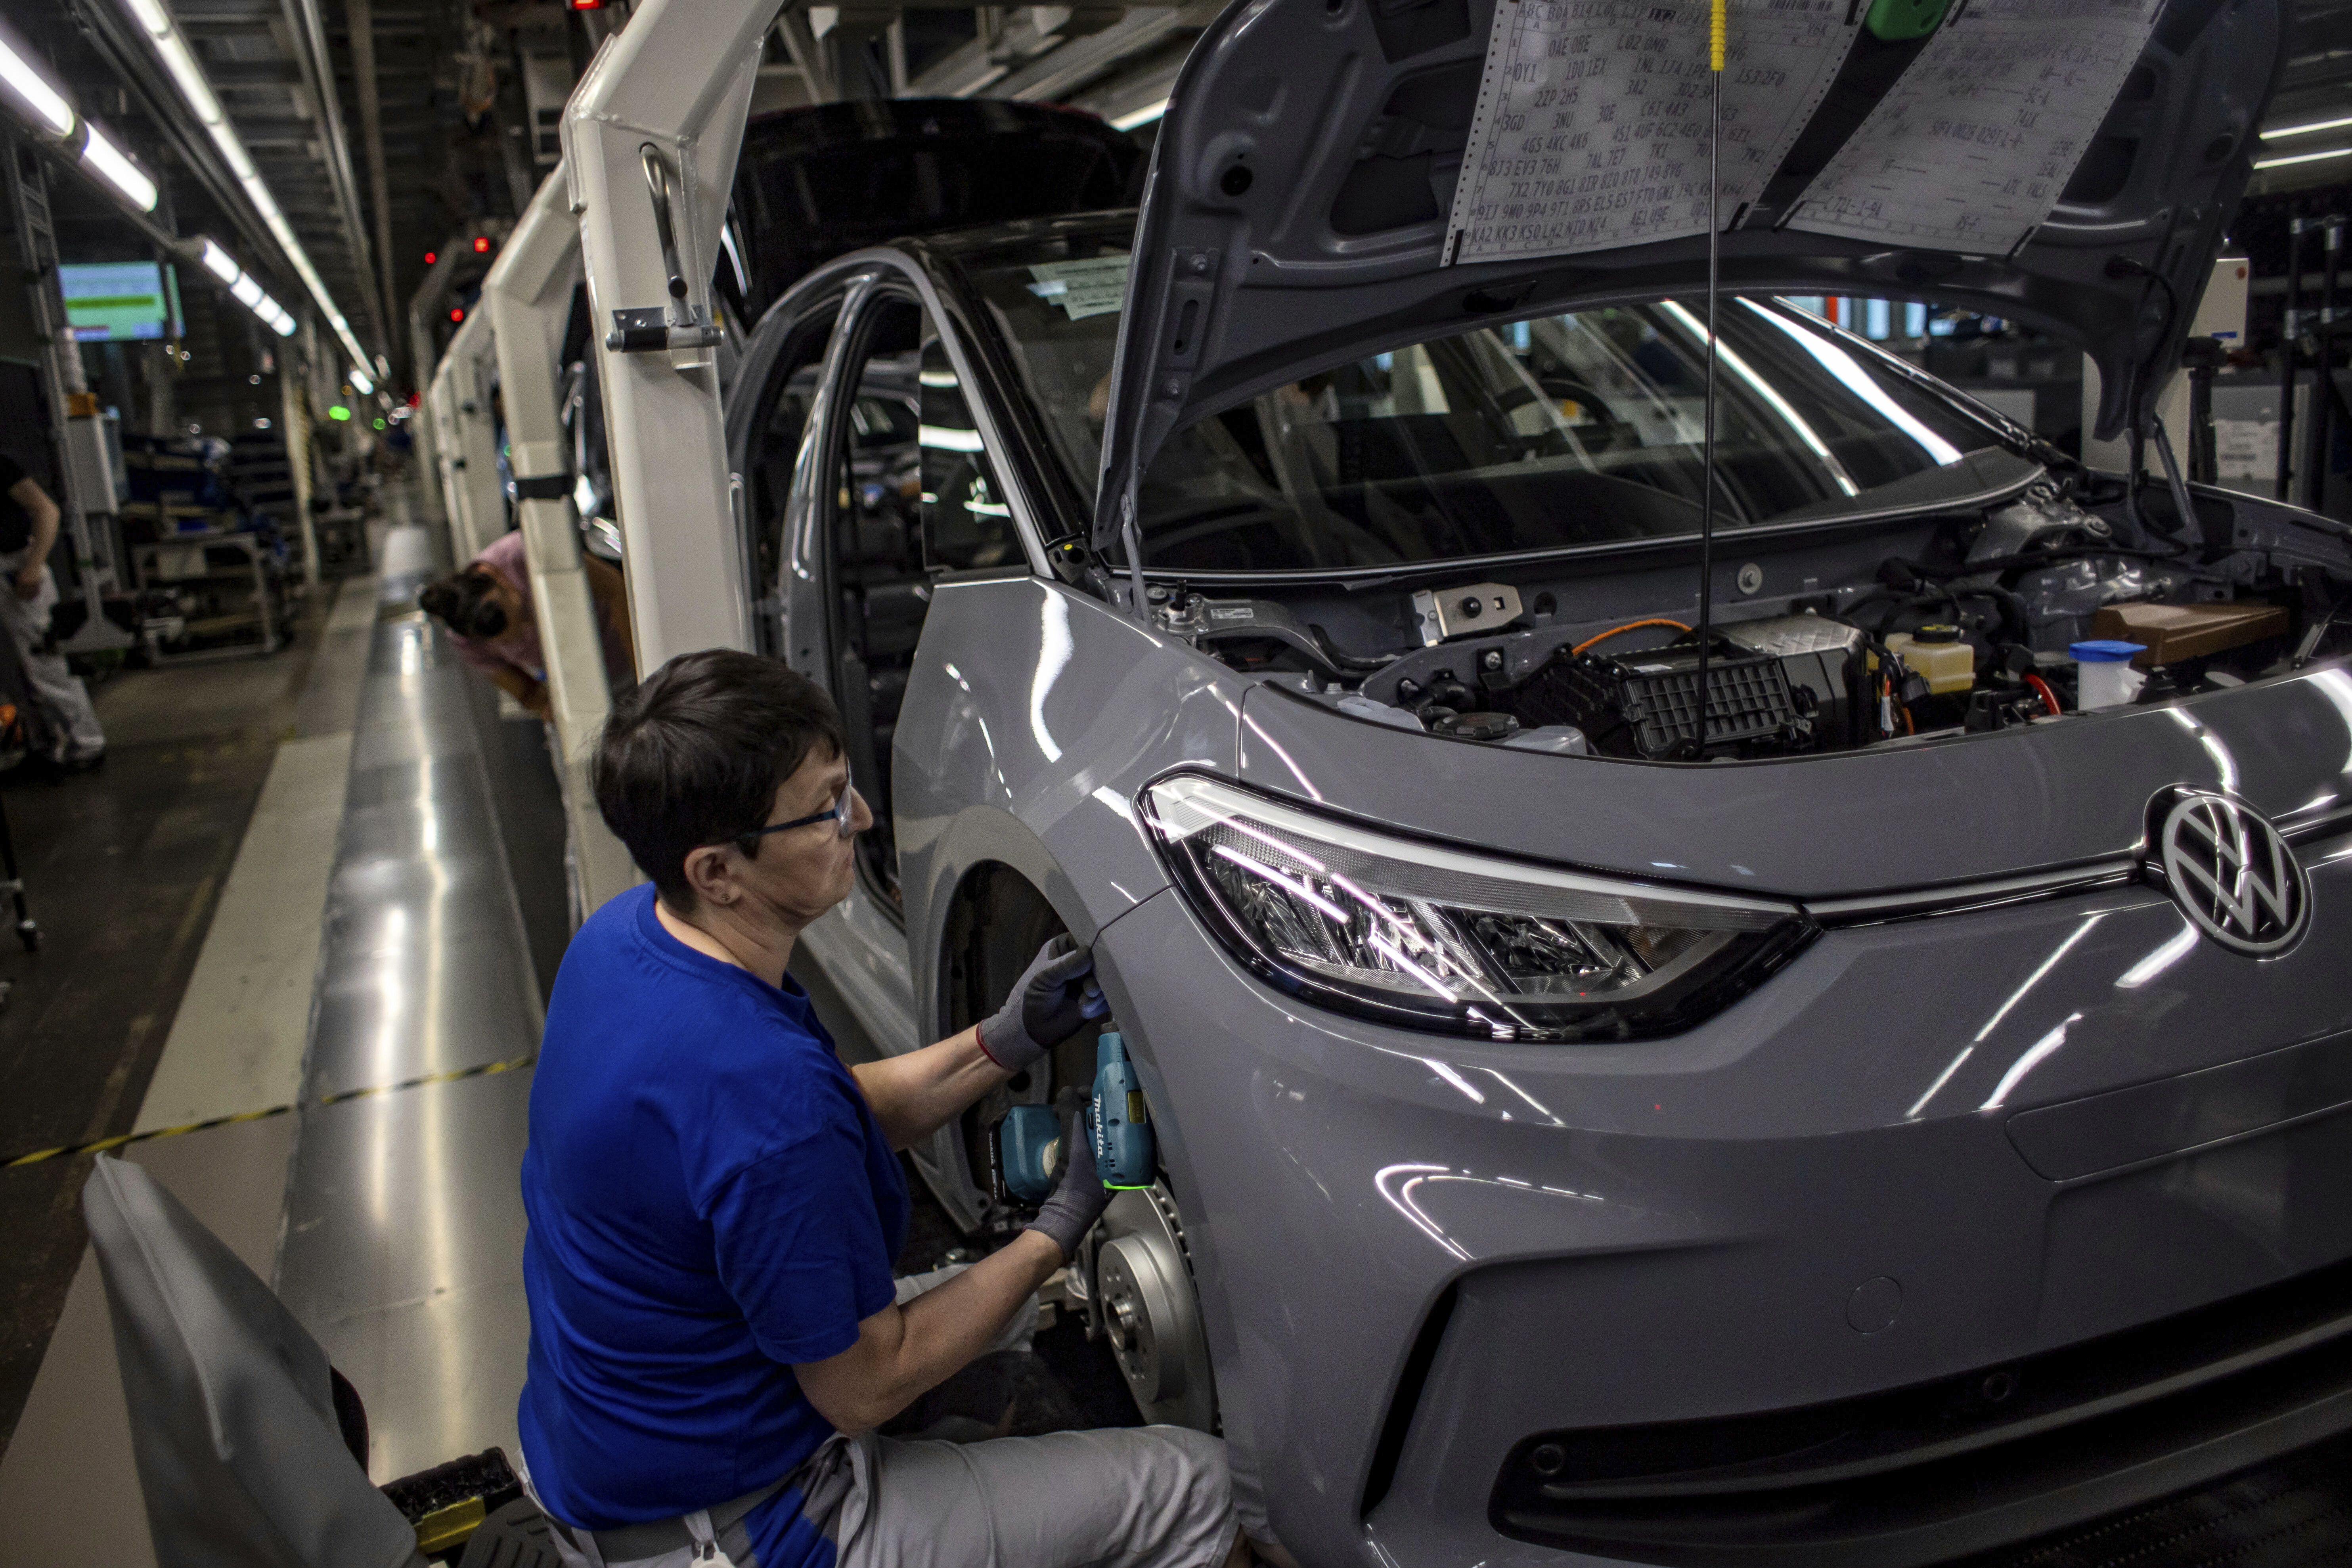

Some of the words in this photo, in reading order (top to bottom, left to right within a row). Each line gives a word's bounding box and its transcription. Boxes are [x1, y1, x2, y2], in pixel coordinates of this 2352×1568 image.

[1572, 4, 1593, 18] B14
[1561, 22, 1567, 30] B
[1511, 38, 1517, 48] 1
[1506, 66, 1512, 75] 2
[1586, 57, 1608, 77] 1EX
[1500, 92, 1508, 101] 3
[1625, 79, 1648, 96] 3A2
[1502, 114, 1525, 131] 3GD
[1552, 111, 1574, 130] 3NU
[1487, 141, 1495, 149] 5
[1514, 159, 1537, 176] EV3
[1540, 158, 1562, 174] 76H
[1509, 182, 1530, 198] 7X2
[1526, 203, 1547, 218] 9P4
[1472, 226, 1492, 243] KA2
[1495, 225, 1517, 241] KK3
[2165, 798, 2302, 948] VW
[1094, 1093, 1104, 1159] makita
